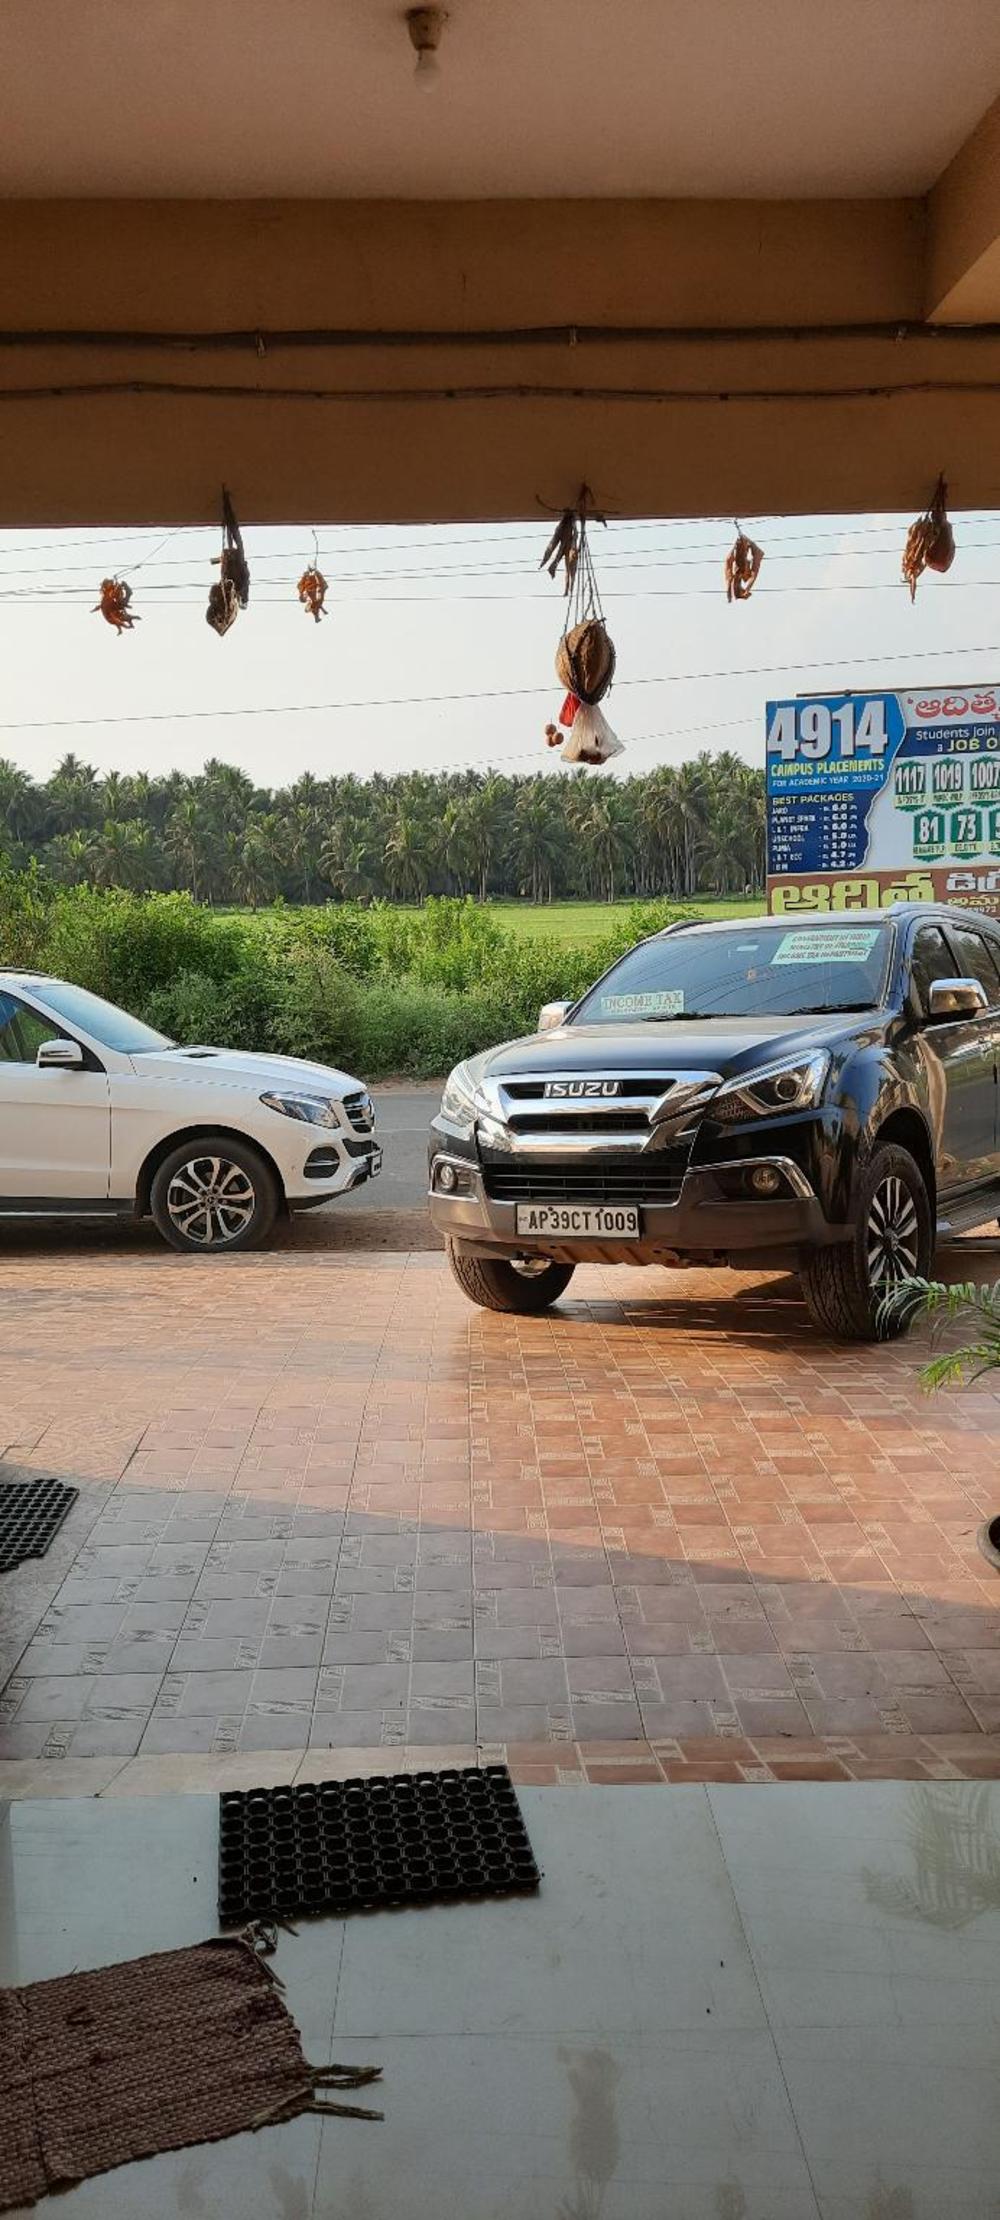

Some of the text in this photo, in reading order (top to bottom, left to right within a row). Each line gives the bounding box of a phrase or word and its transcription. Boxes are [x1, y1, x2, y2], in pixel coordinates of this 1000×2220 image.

[768, 700, 888, 760] 4914
[916, 728, 969, 740] Students
[947, 738, 980, 752] JOB
[771, 759, 885, 777] CAMPUS PLACEMENTS
[935, 763, 962, 790] 1019
[972, 762, 1000, 789] 1007
[788, 777, 827, 787] ACADEMIC
[829, 776, 849, 784] YEAR
[896, 765, 925, 793] 1117
[772, 793, 855, 806] BEST PACKAGES
[919, 815, 938, 843] 81
[958, 814, 976, 841] 73
[603, 996, 653, 1010] INCOME
[656, 992, 682, 1004] TAX
[545, 1081, 620, 1097] ISUZU
[528, 1210, 636, 1232] AP39CT1009
